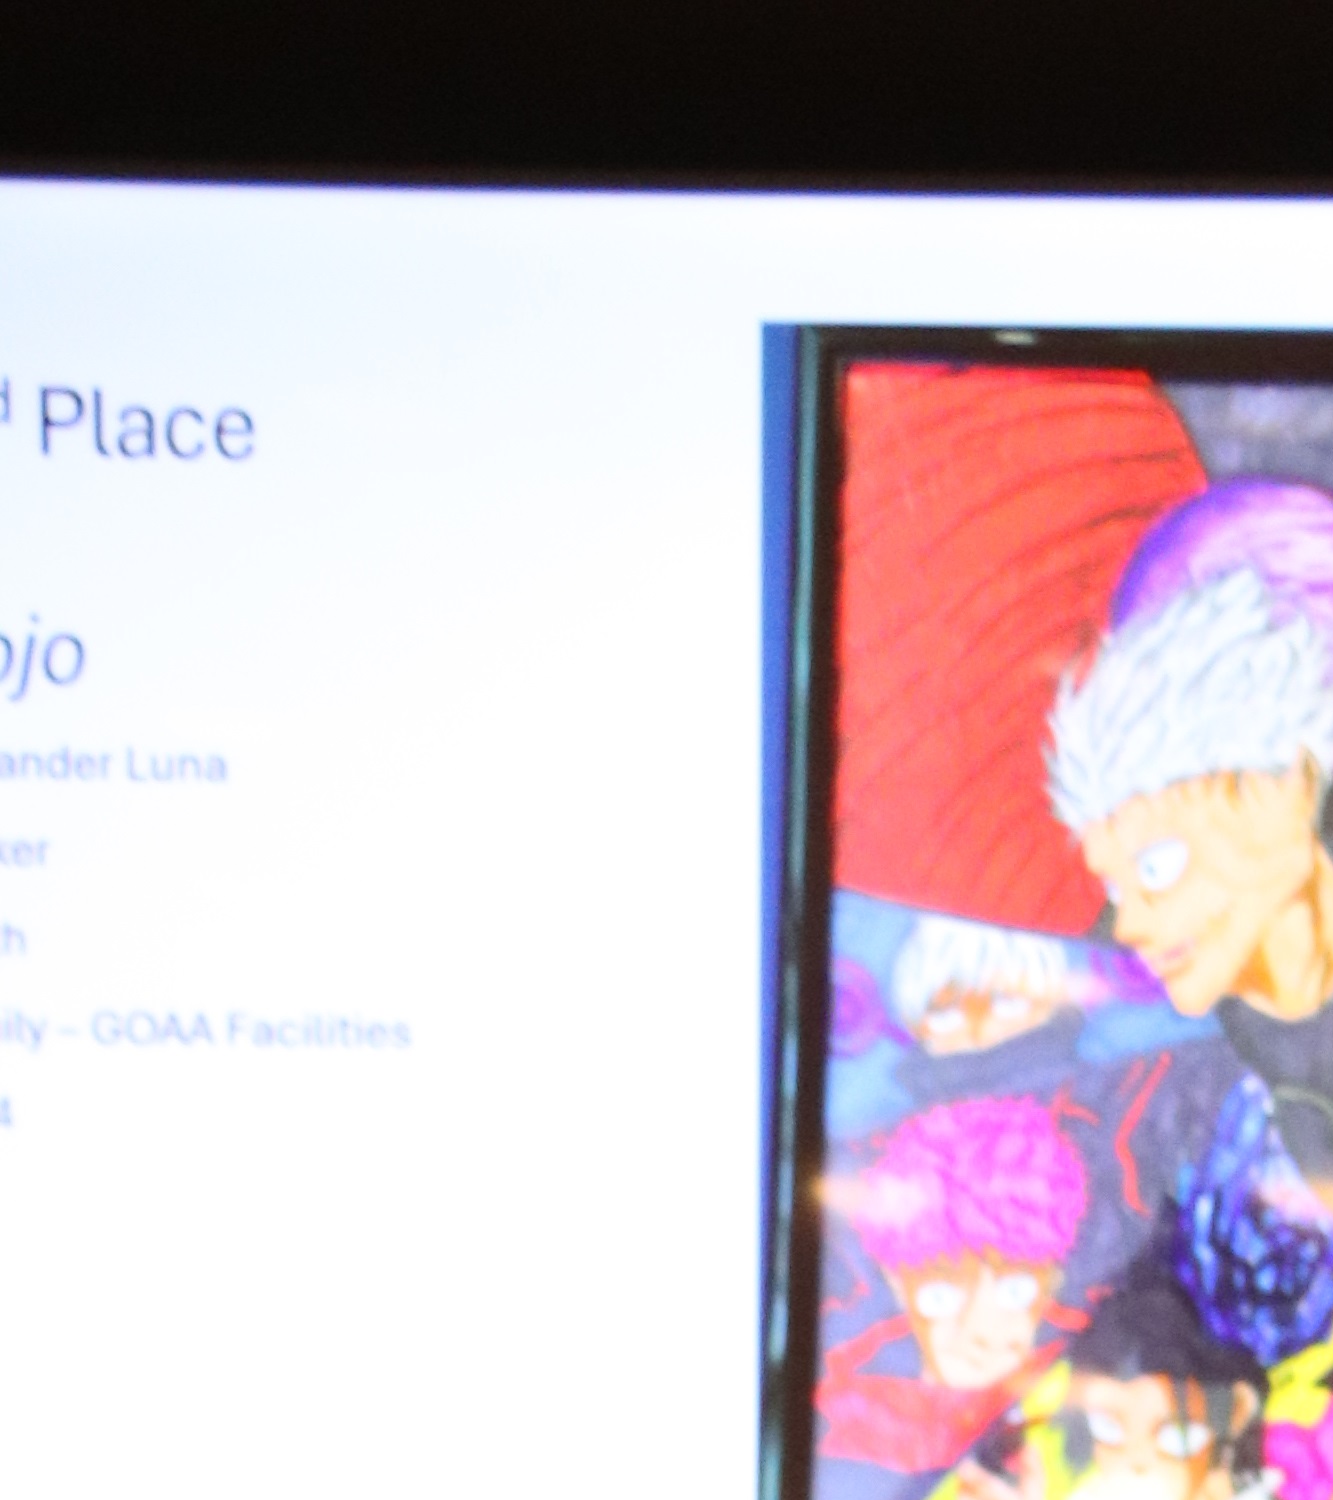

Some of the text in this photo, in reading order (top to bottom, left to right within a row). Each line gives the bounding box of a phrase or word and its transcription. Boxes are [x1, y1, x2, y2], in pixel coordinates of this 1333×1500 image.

[40, 384, 256, 461] Place
[124, 745, 229, 784] Luna
[89, 1008, 215, 1047] GOAA
[226, 1010, 413, 1049] Facilities
